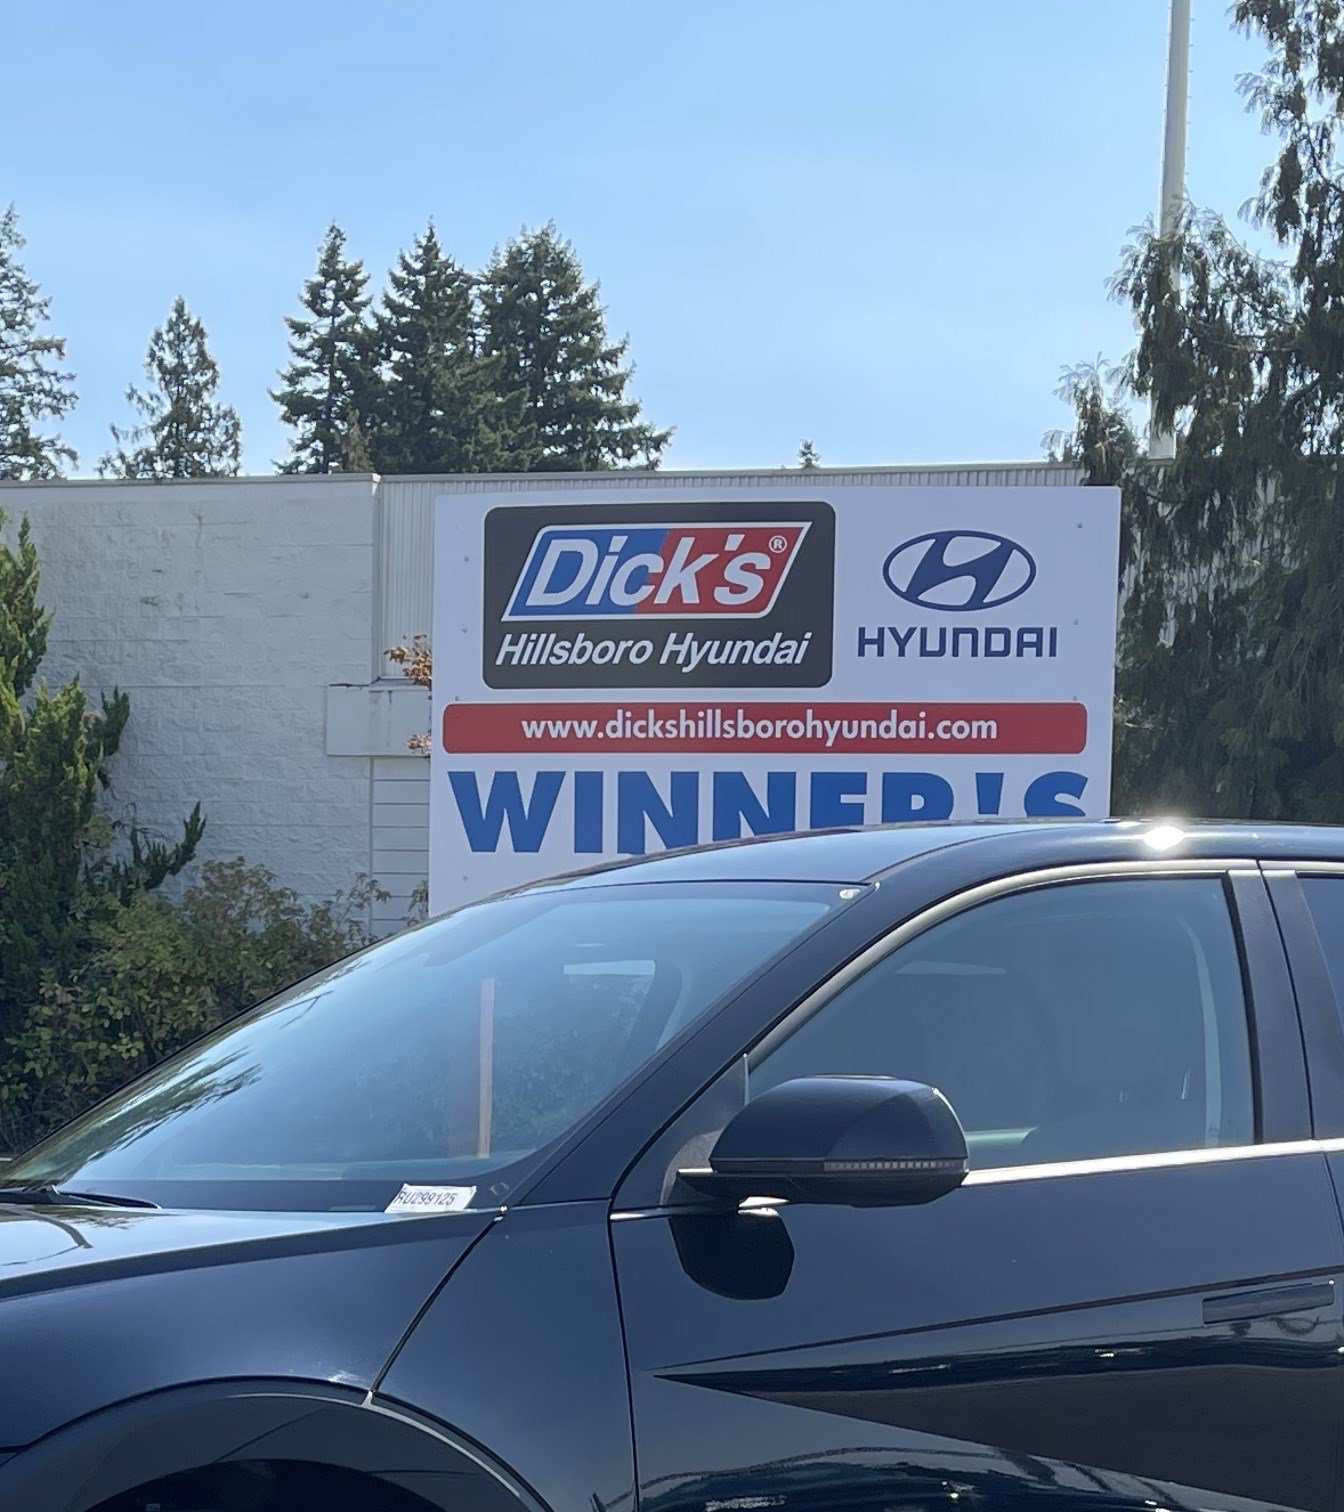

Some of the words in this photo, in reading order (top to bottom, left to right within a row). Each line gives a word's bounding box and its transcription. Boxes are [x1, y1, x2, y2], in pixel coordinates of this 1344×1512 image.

[495, 632, 652, 667] Hillsboro
[659, 632, 813, 673] Hyundai
[858, 626, 1058, 659] HYUNDAI
[521, 708, 997, 748] www.dickshillsborohyundai.com
